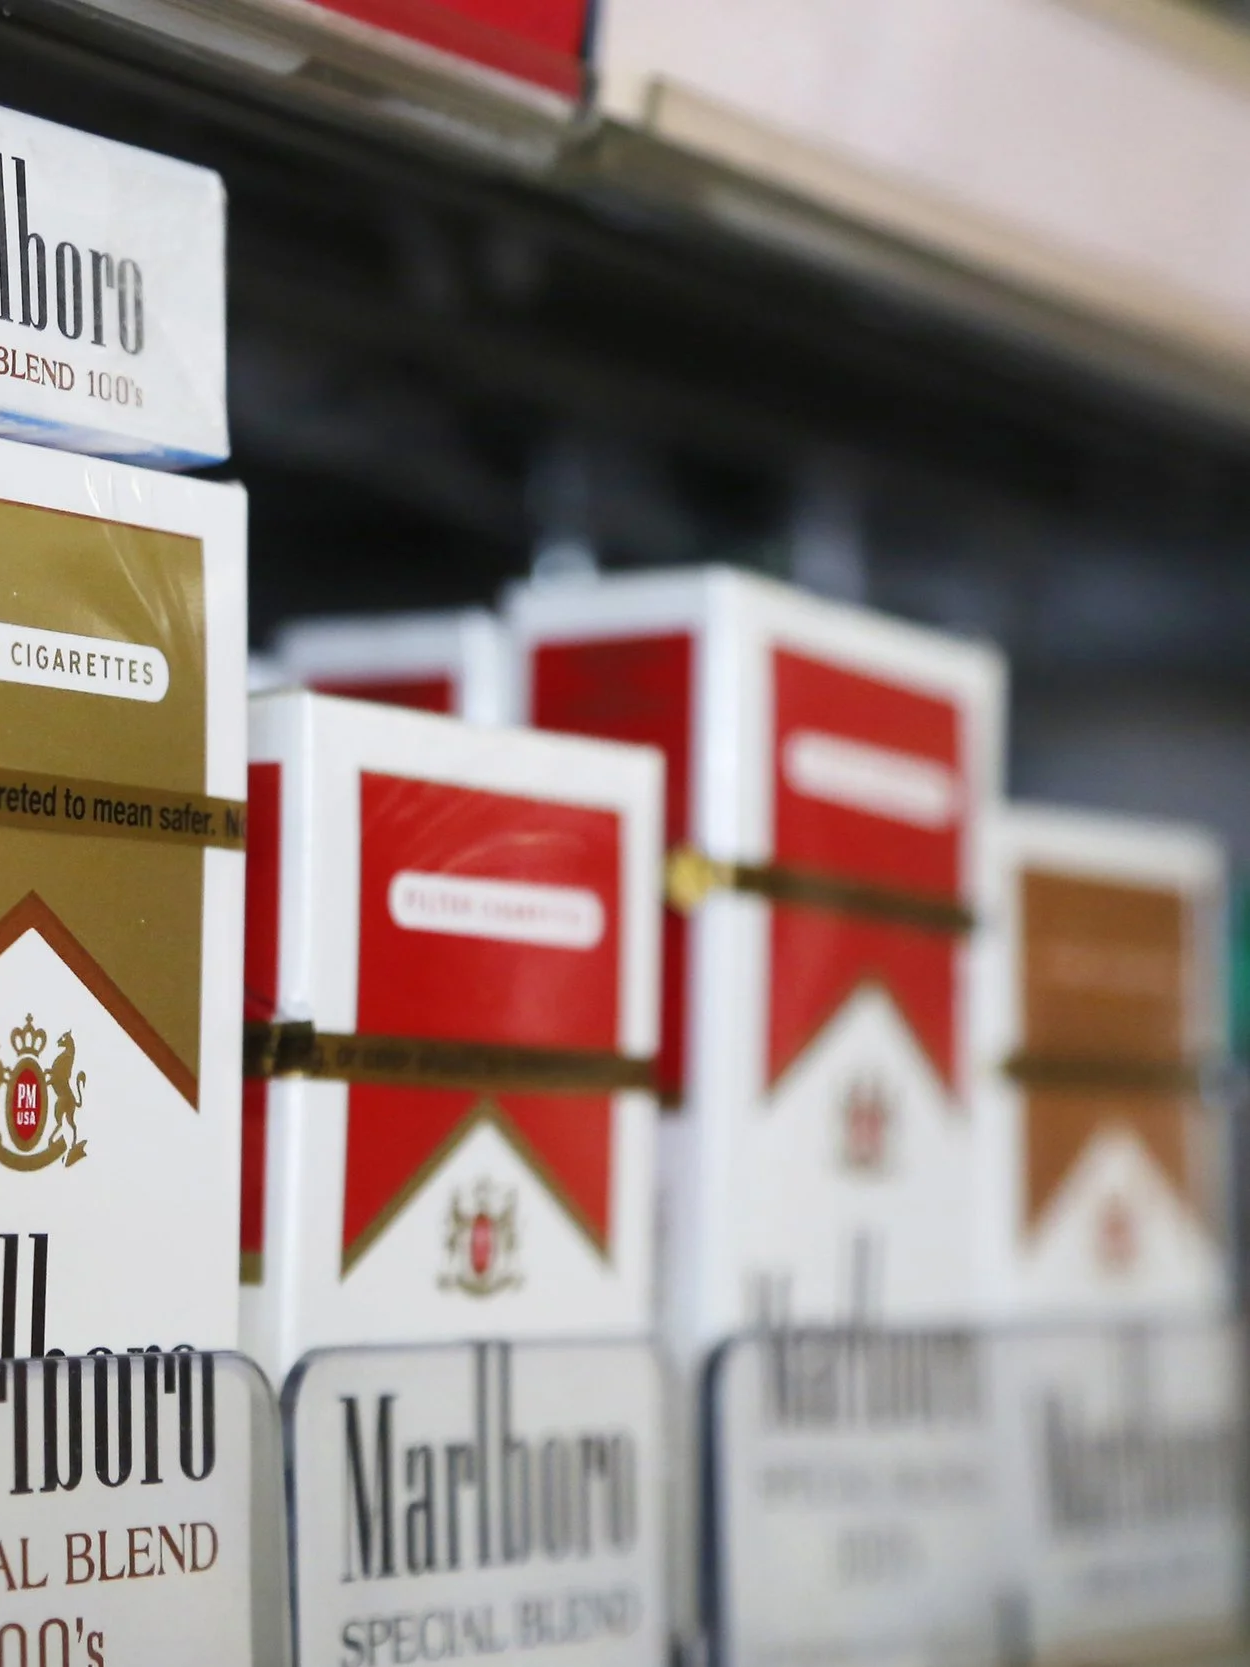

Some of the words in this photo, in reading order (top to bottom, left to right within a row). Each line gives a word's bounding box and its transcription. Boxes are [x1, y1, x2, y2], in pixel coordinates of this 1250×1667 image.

[86, 369, 144, 408] 100's
[10, 640, 154, 686] CIGARETTES
[63, 787, 87, 821] to
[92, 798, 153, 829] mean
[158, 805, 217, 837] safer.
[15, 1111, 37, 1126] USA
[16, 1082, 38, 1110] PM
[339, 1341, 638, 1584] Marlboro
[64, 1521, 220, 1585] BLEND
